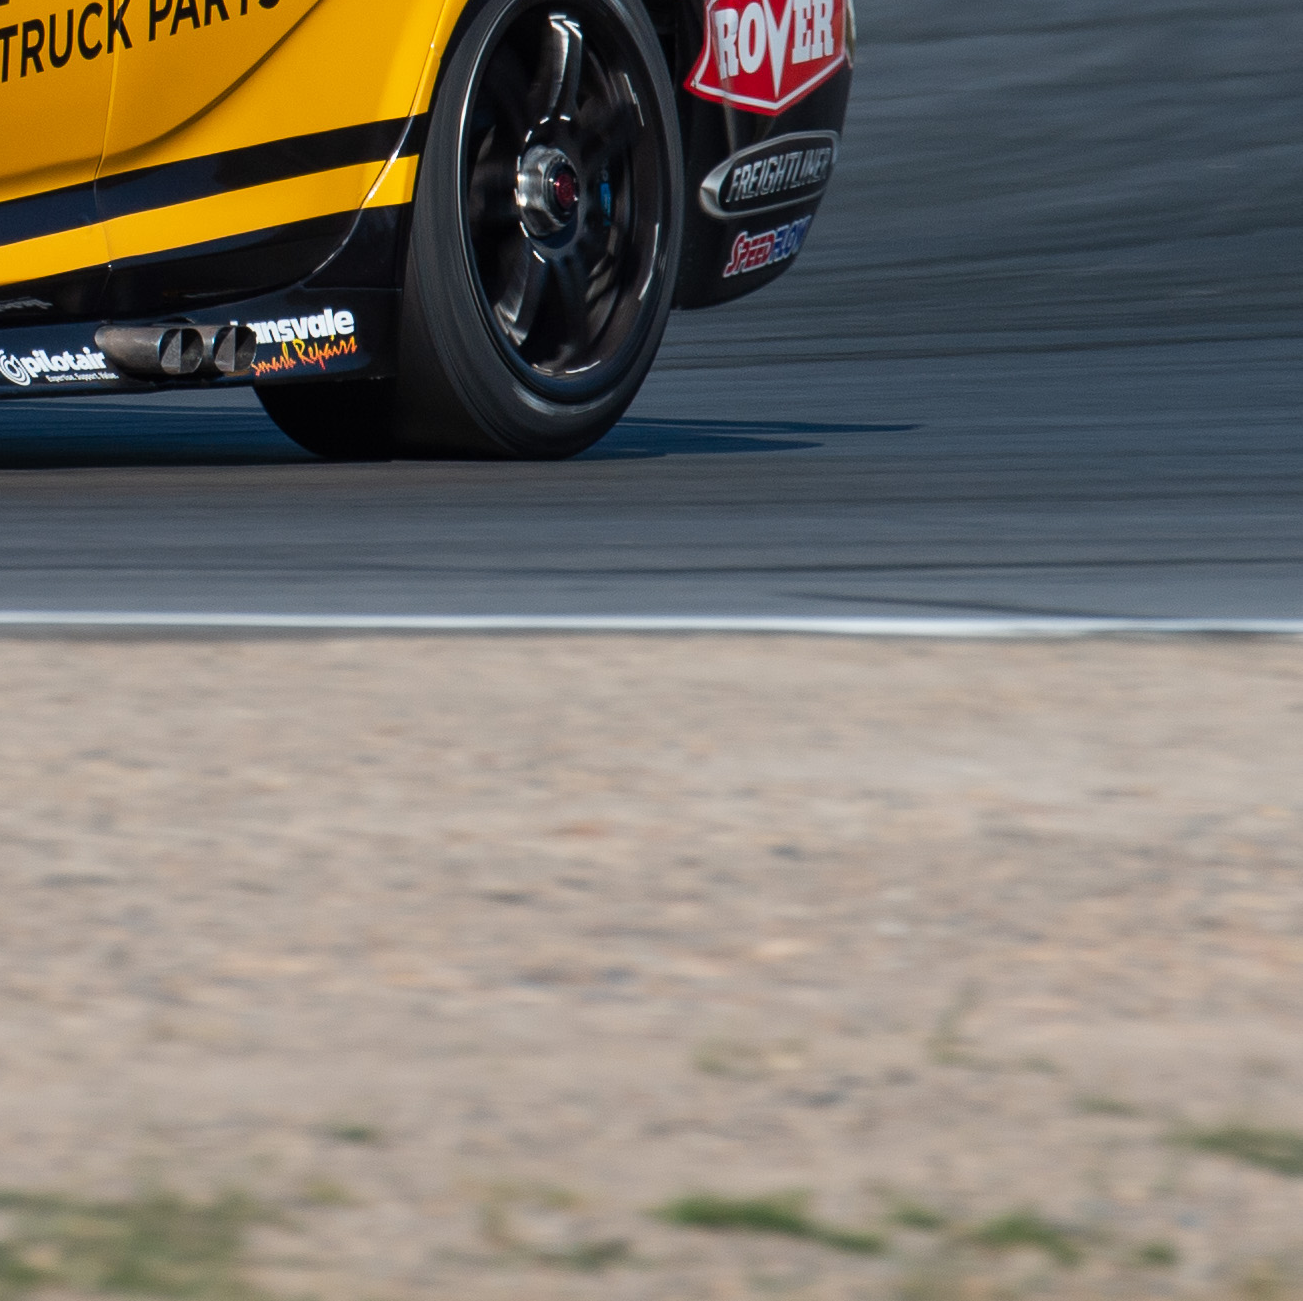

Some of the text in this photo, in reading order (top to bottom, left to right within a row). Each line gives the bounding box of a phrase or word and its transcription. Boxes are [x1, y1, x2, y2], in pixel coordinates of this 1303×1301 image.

[230, 308, 355, 344] ansvale
[20, 346, 107, 378] pilotair
[292, 335, 358, 371] Repairs
